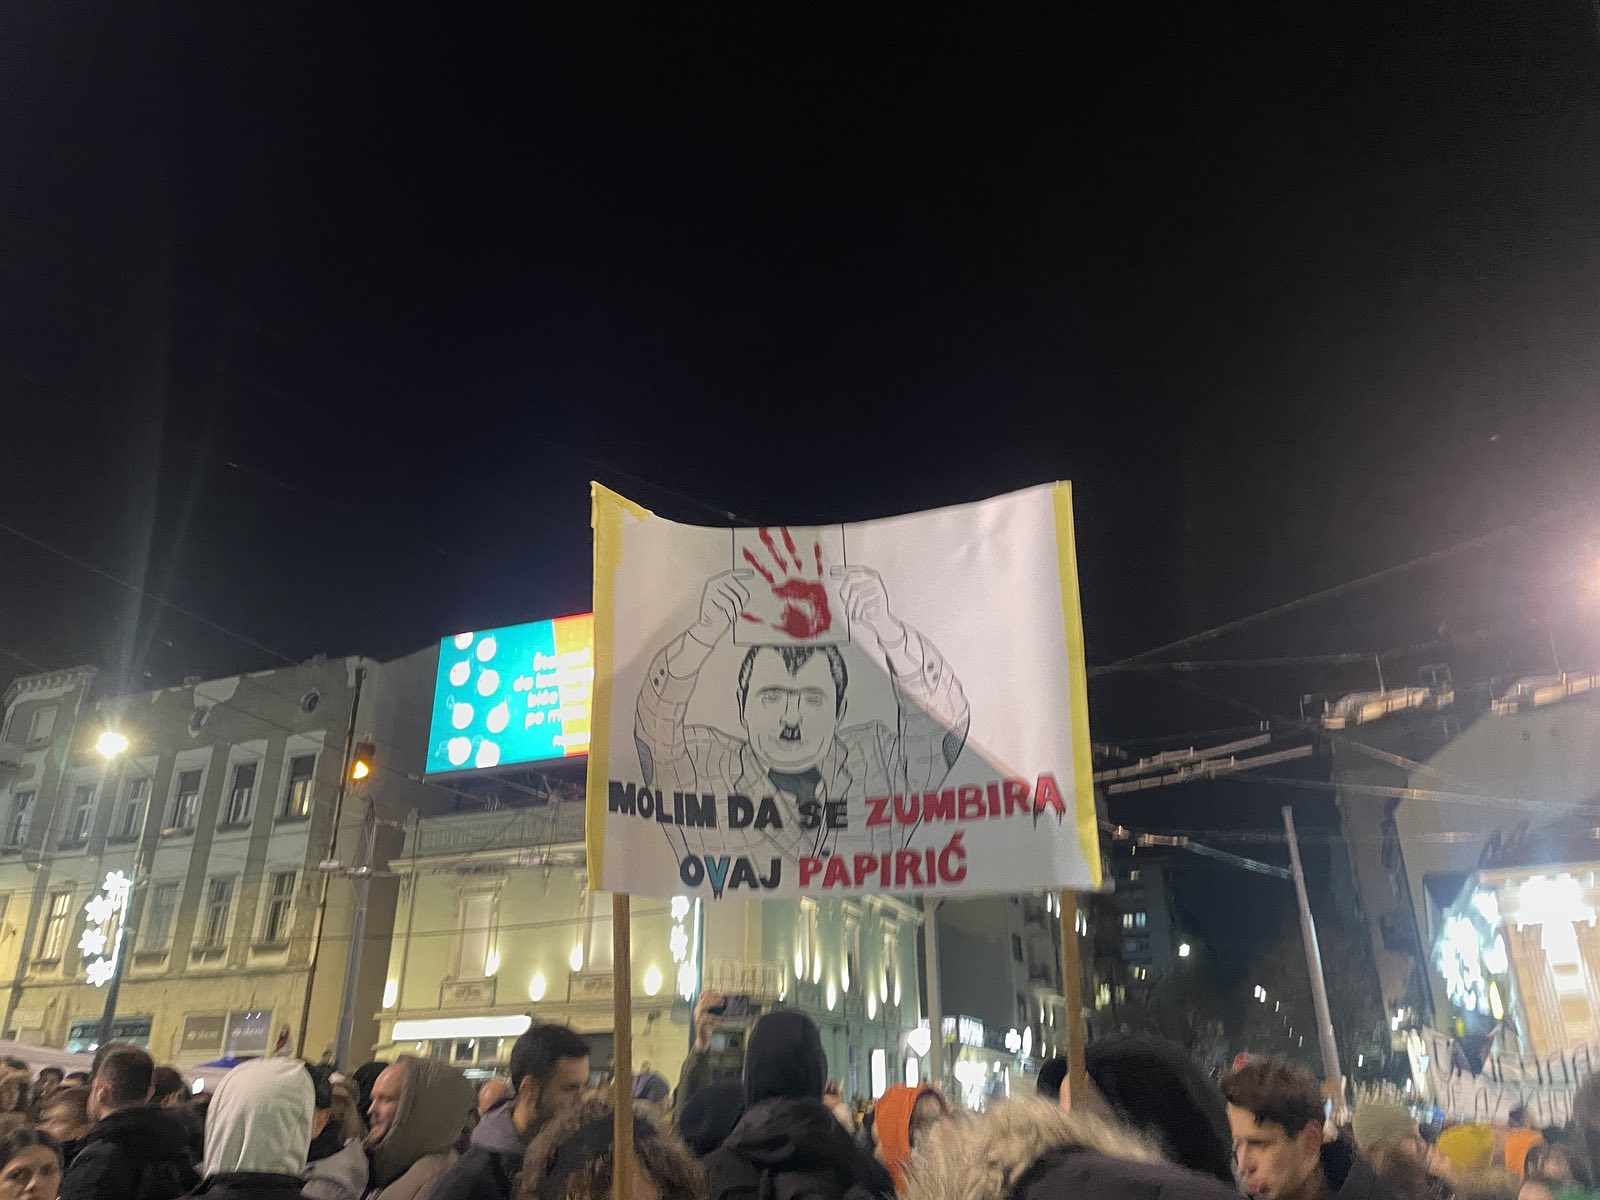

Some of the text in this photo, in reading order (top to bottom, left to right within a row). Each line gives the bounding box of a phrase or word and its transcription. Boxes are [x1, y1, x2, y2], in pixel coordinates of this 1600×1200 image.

[608, 774, 1066, 830] MOLIM DA SE ZUMBIRA
[679, 830, 968, 899] OVAJ PAPIRIĆ
